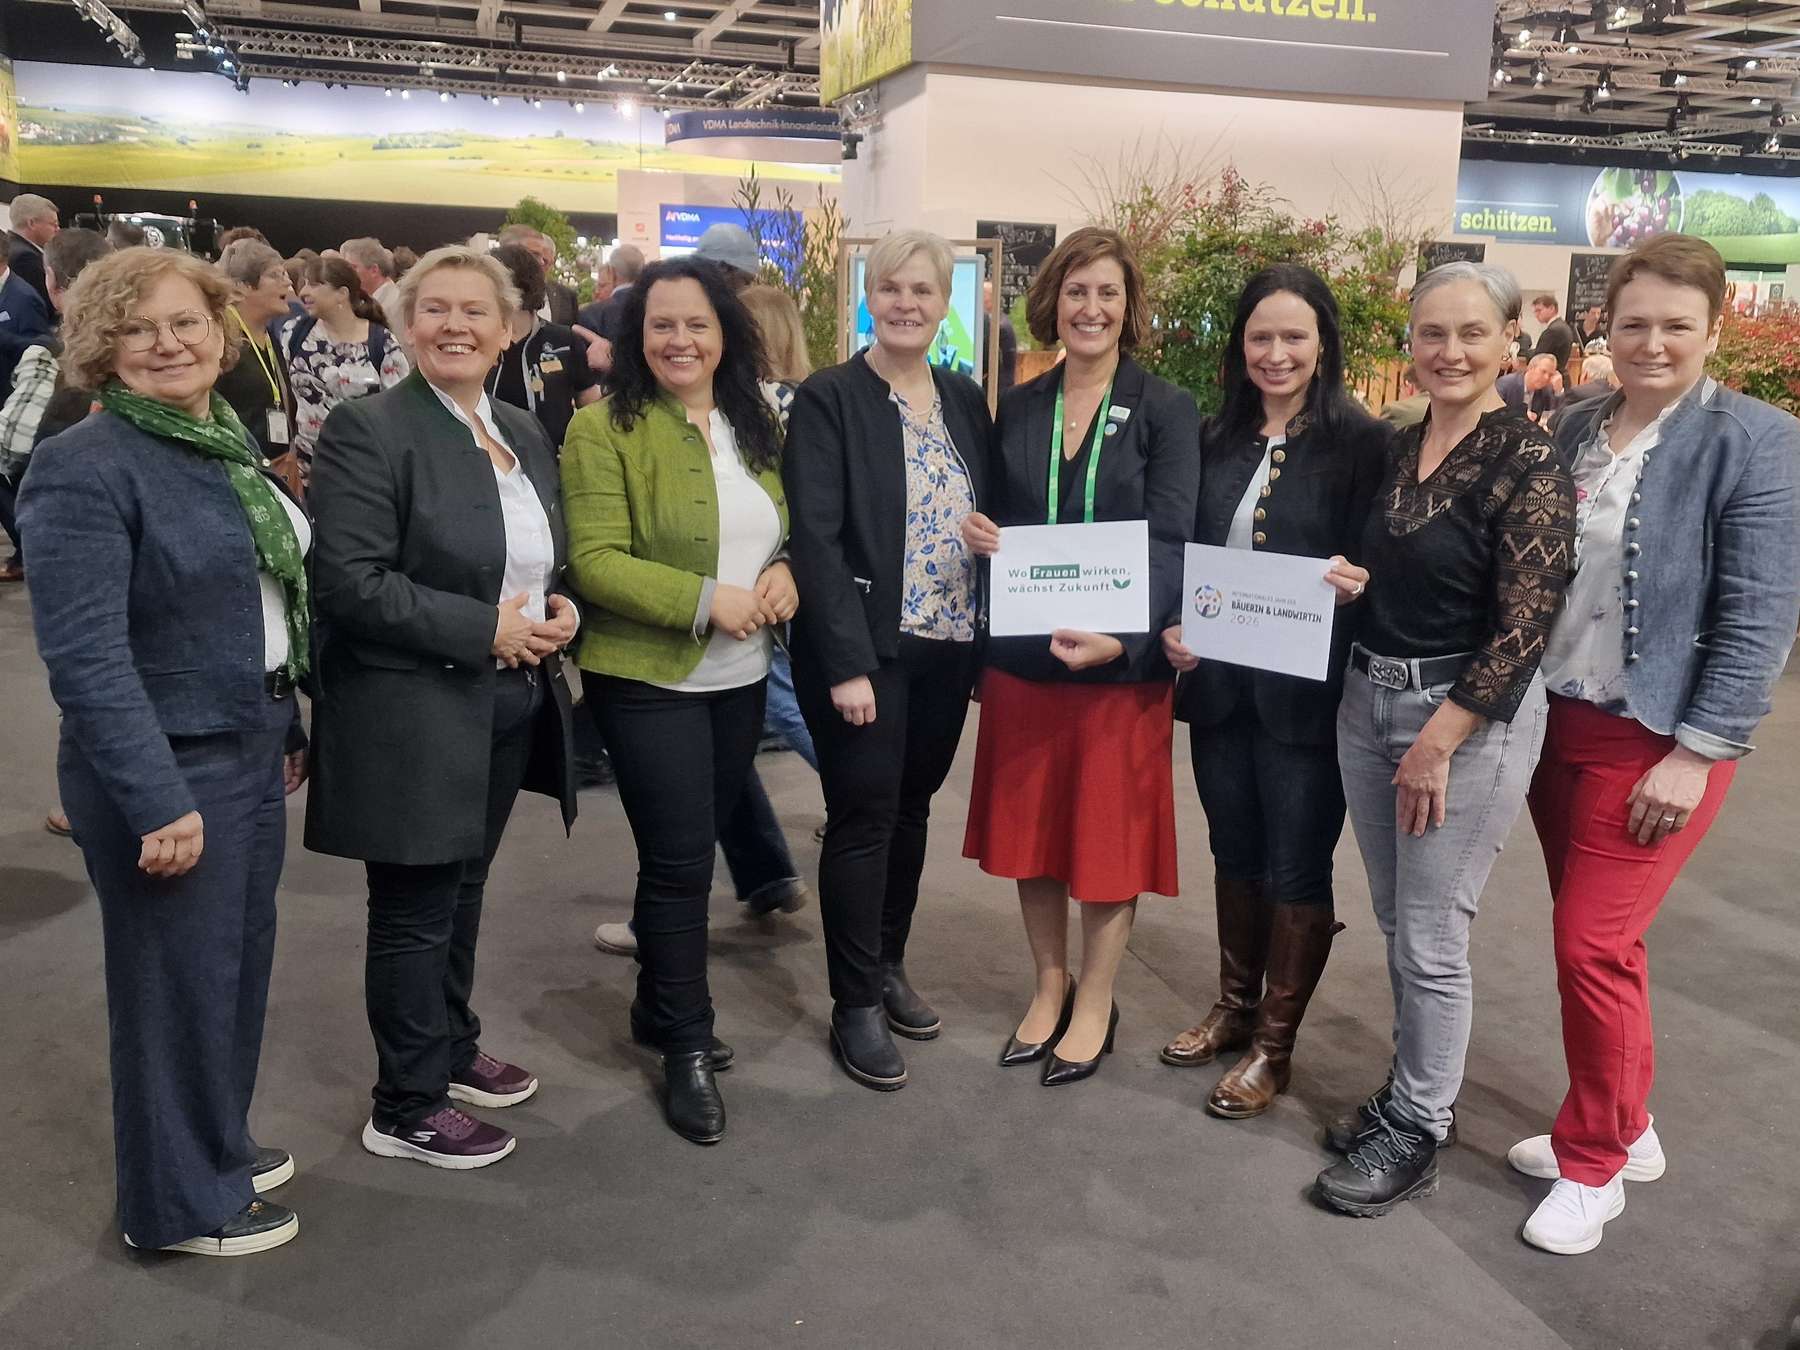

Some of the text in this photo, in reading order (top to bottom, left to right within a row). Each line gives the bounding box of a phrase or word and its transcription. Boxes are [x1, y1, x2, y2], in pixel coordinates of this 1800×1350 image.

[703, 119, 728, 129] VDMA
[1460, 207, 1557, 233] schützen.
[1008, 568, 1027, 578] Wo
[1032, 567, 1078, 579] Frauen
[1008, 583, 1053, 593] wächst
[1231, 599, 1322, 623] BÄUERIN & LANDWIRTIN
